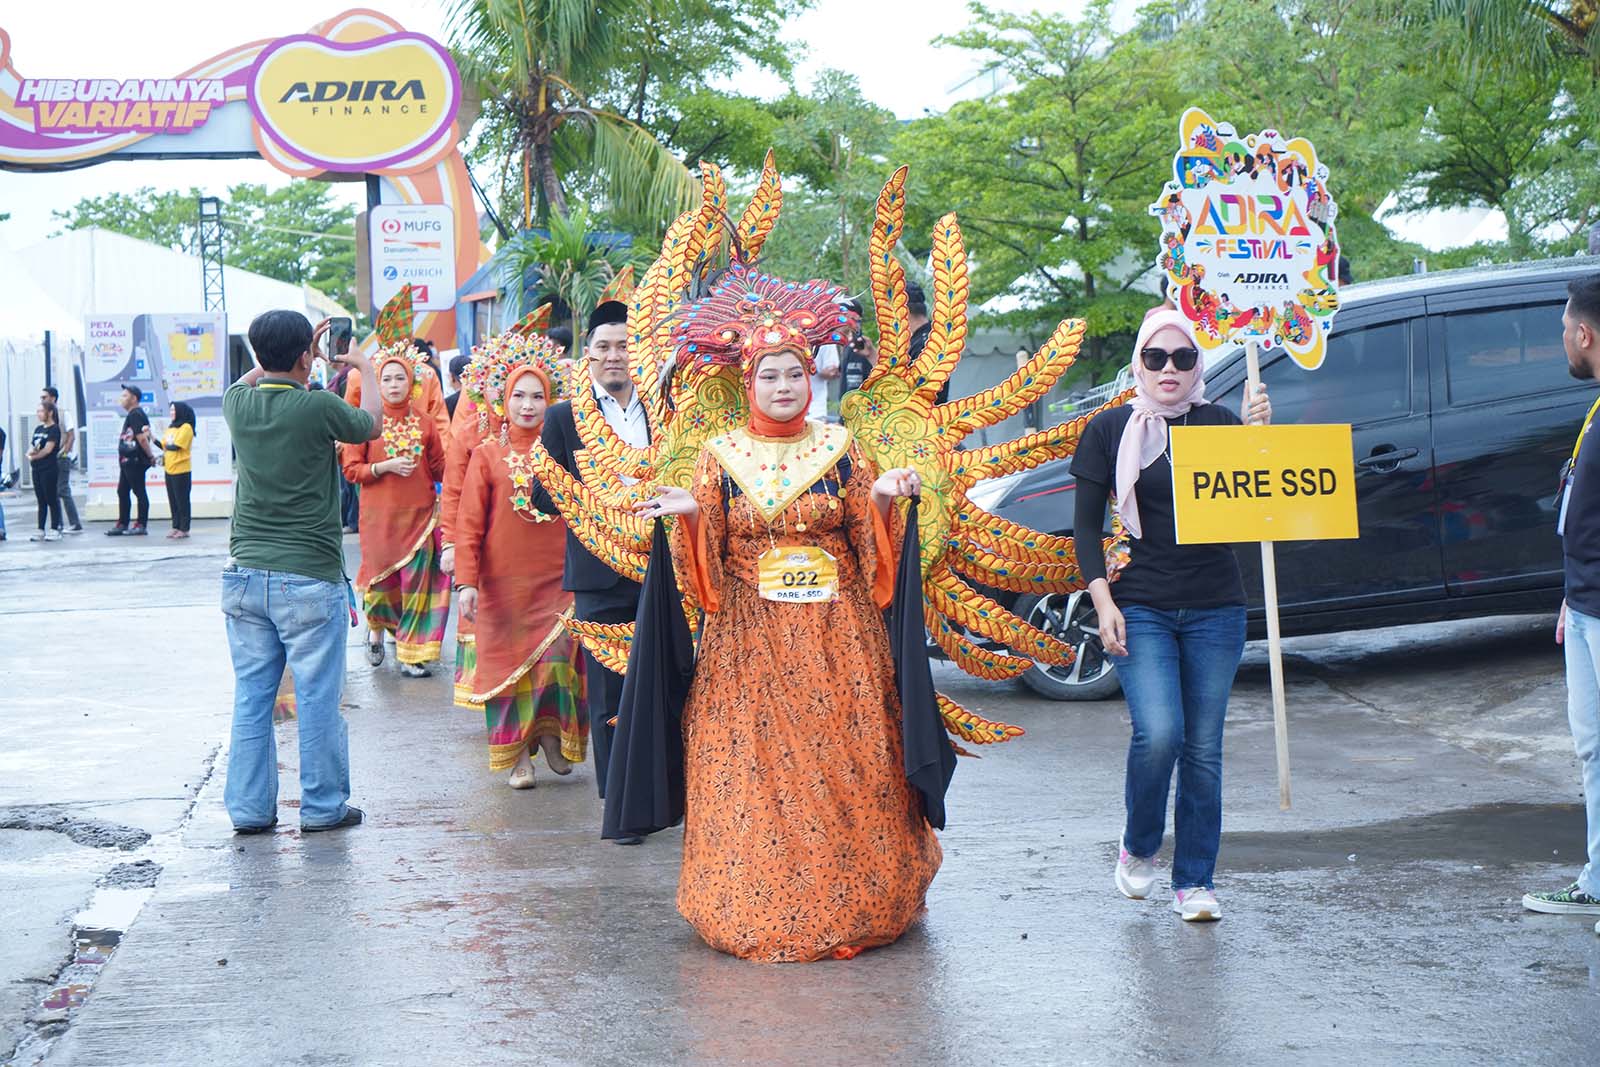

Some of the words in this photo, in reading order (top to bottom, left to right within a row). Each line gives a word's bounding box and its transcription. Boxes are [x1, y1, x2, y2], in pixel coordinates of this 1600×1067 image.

[20, 79, 224, 101] HIBURANNYA
[278, 79, 426, 103] ADIRA
[38, 101, 212, 128] VARIATIF
[312, 104, 428, 115] FINANCE
[1194, 194, 1311, 236] ADIRA
[404, 221, 442, 231] MUFG
[1216, 239, 1293, 259] FESTIVAL
[403, 268, 442, 278] ZURICH
[1233, 273, 1289, 283] ADIRA
[90, 321, 114, 329] PETA
[90, 330, 126, 338] LOKASI
[1193, 470, 1272, 499] PARE
[1281, 468, 1337, 497] SSD
[782, 571, 818, 587] 022
[777, 591, 800, 599] PARE
[806, 590, 824, 598] SSD
